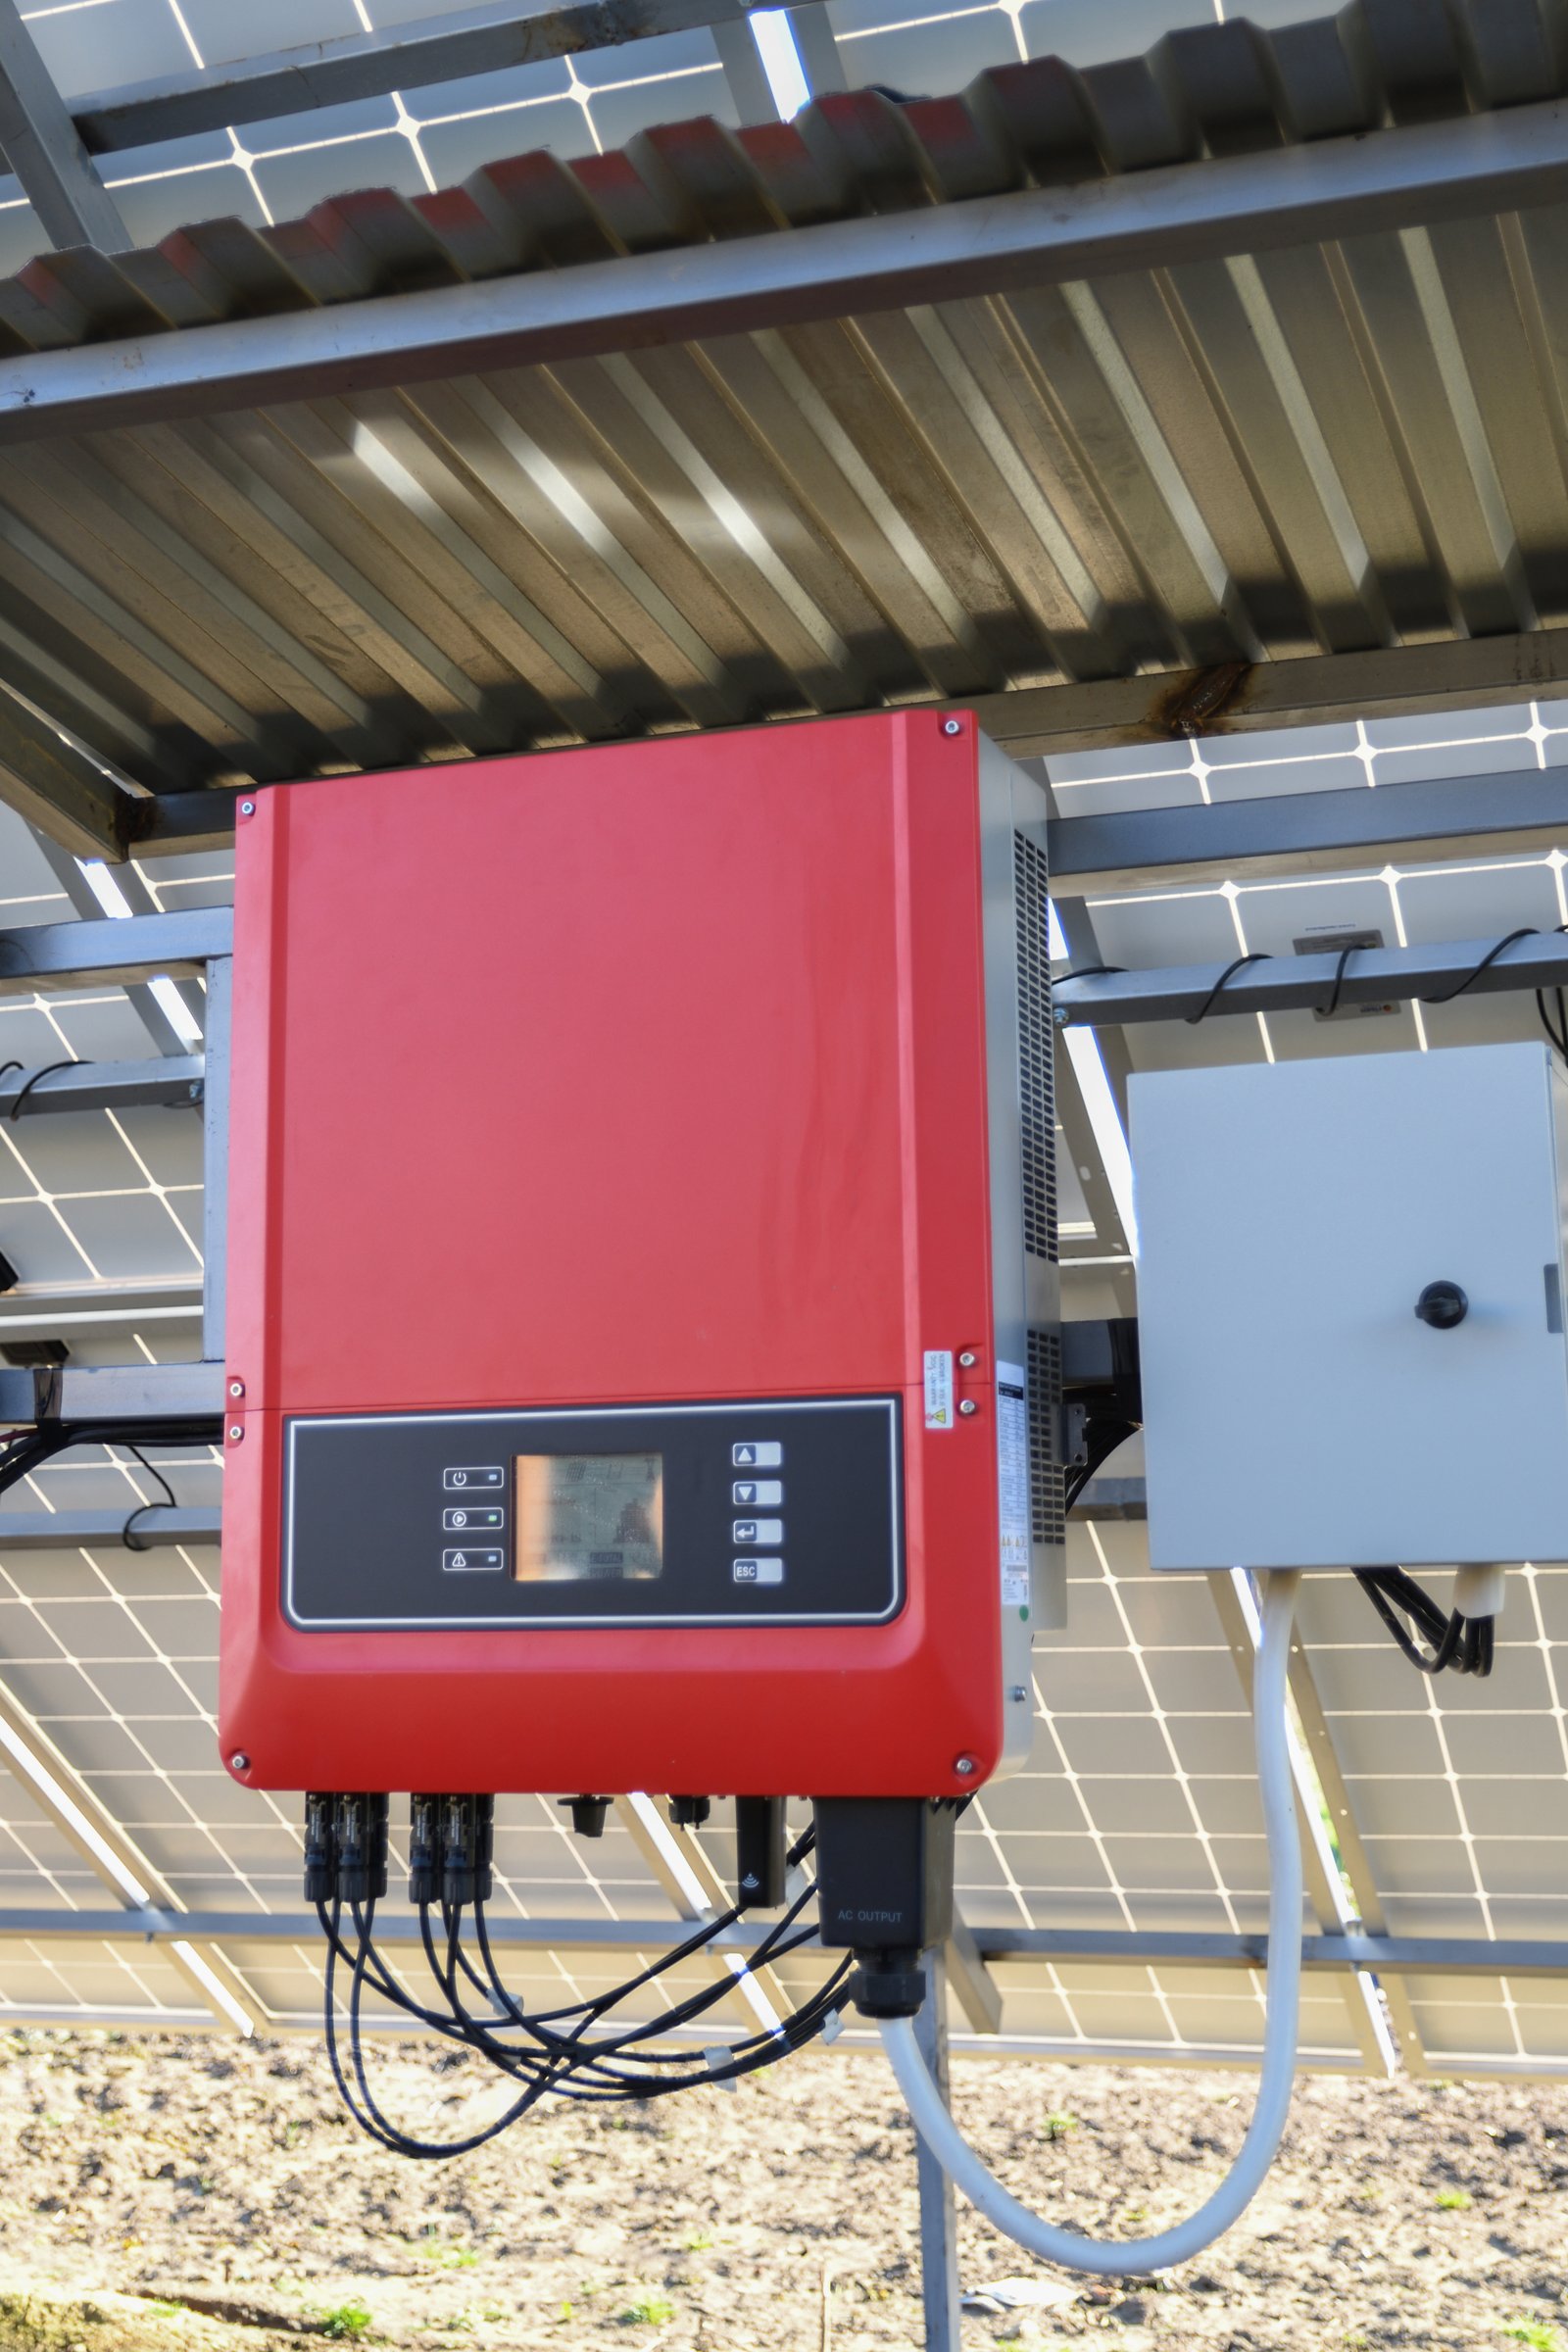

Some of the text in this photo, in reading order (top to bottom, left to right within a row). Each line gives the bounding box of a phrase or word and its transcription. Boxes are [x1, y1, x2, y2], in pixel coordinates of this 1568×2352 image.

[736, 1566, 756, 1577] ESC
[838, 1909, 903, 1923] AC OUTPUT
